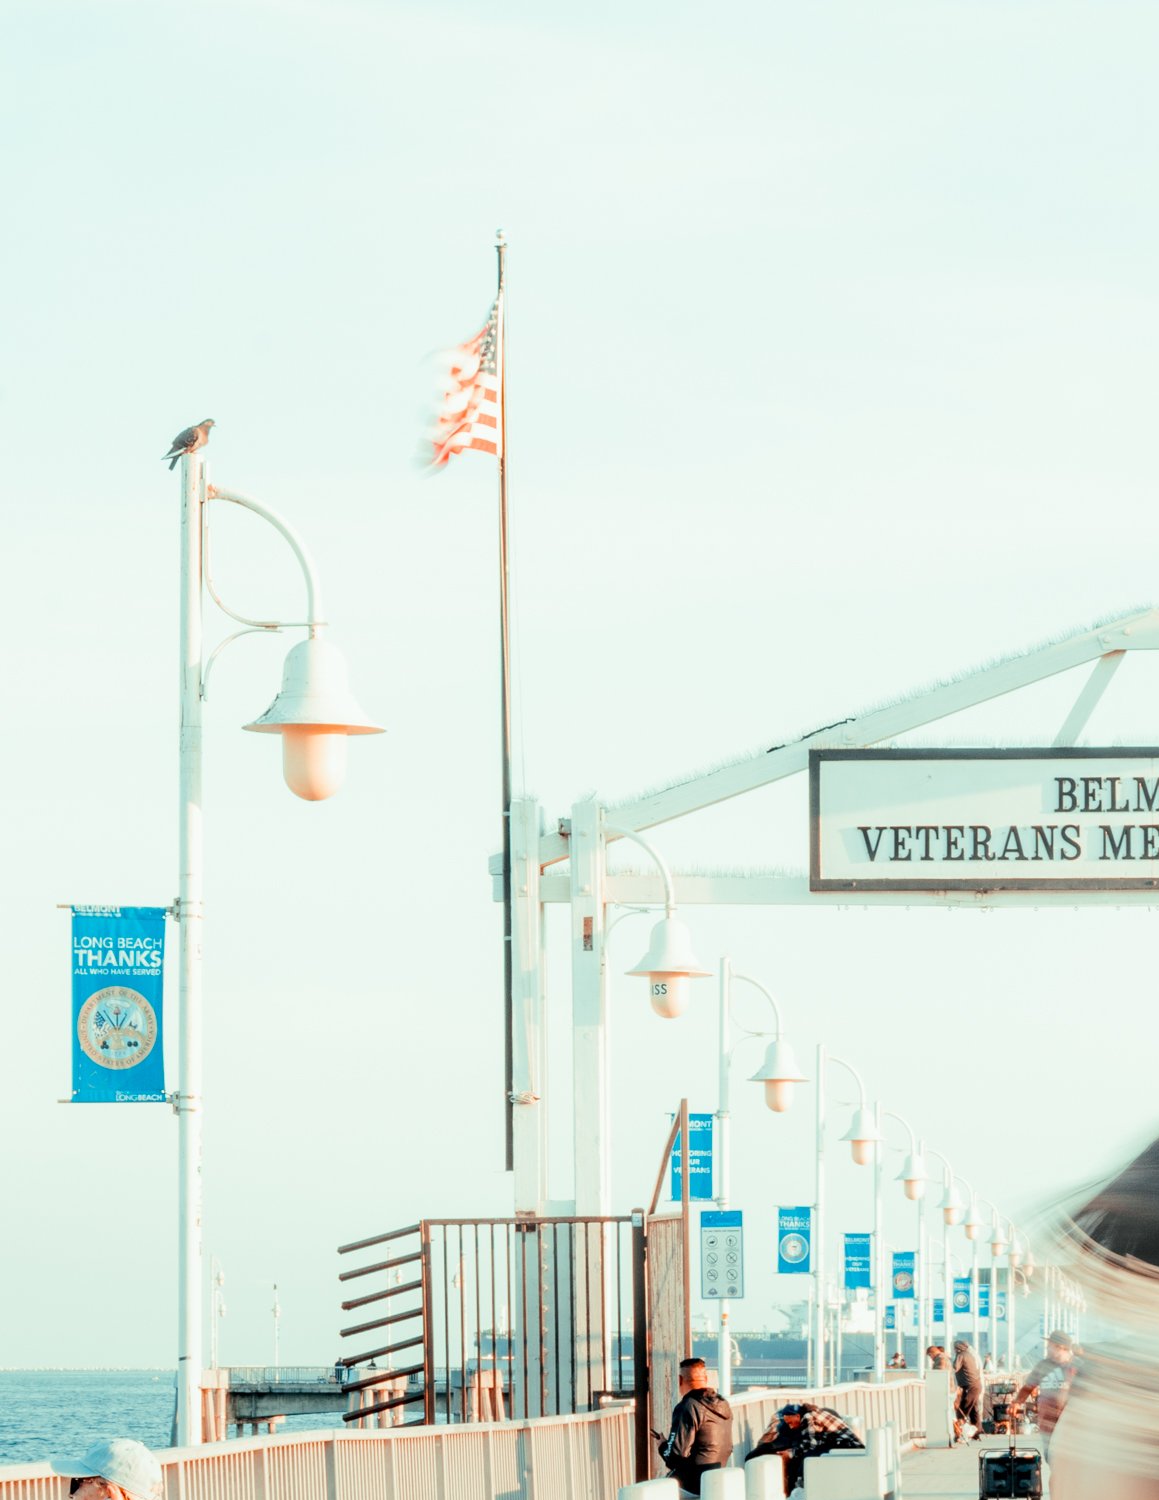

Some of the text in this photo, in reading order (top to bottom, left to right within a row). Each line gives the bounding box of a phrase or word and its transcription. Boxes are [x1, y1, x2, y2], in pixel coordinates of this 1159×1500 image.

[857, 824, 1082, 862] VETERANS
[74, 937, 163, 949] LONG BEACH
[74, 950, 162, 968] THANKS
[74, 968, 88, 976] ALL
[111, 968, 131, 976] HAVE
[132, 968, 162, 976] SERVED
